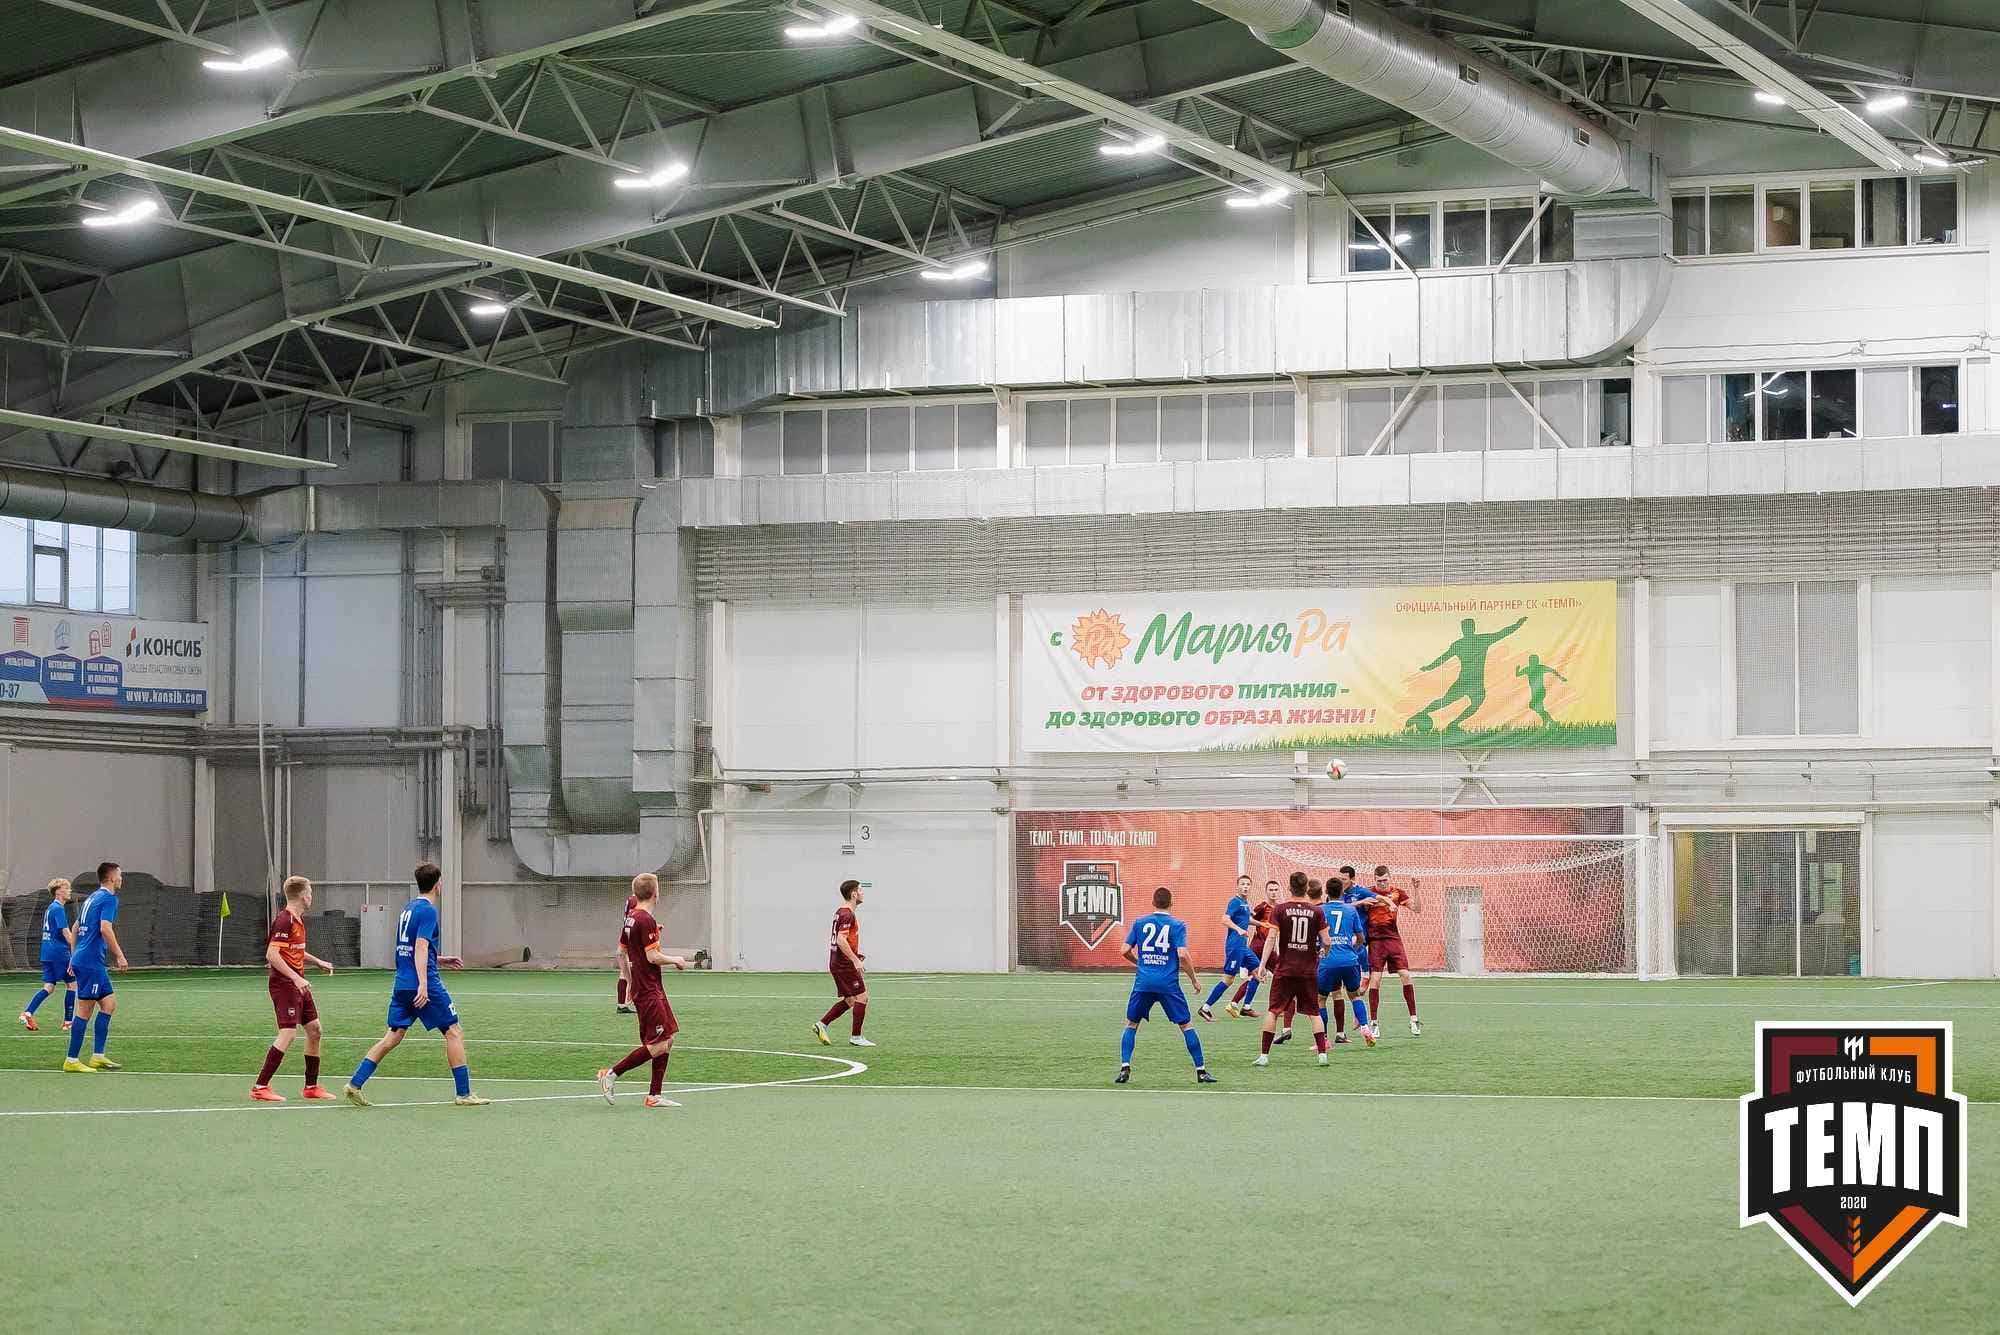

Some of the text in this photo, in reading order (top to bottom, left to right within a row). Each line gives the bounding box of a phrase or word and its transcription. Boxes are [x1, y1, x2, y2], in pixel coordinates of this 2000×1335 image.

[1395, 598, 1477, 613] ОФИЦИАЛЬНЫЙ
[1526, 599, 1538, 609] СК
[1541, 597, 1584, 609] «ТЕМП»
[143, 637, 202, 657] КОНСИБ
[126, 690, 203, 705] www.konsib.com
[1081, 685, 1108, 700] ОТ
[1111, 683, 1234, 704] ЗДОРОВОГО
[1238, 682, 1337, 699] ПИТАНИЯ
[1045, 711, 1076, 729] ДО
[1079, 710, 1201, 729] ЗДОРОВОГО
[1204, 709, 1283, 726] ОБРАЗА
[861, 825, 870, 840] 3
[1089, 830, 1126, 847] ТОЛЬКО
[1066, 885, 1118, 916] ТЕМП
[1291, 916, 1309, 943] 10
[1331, 910, 1343, 934] 7
[1142, 923, 1170, 953] 24
